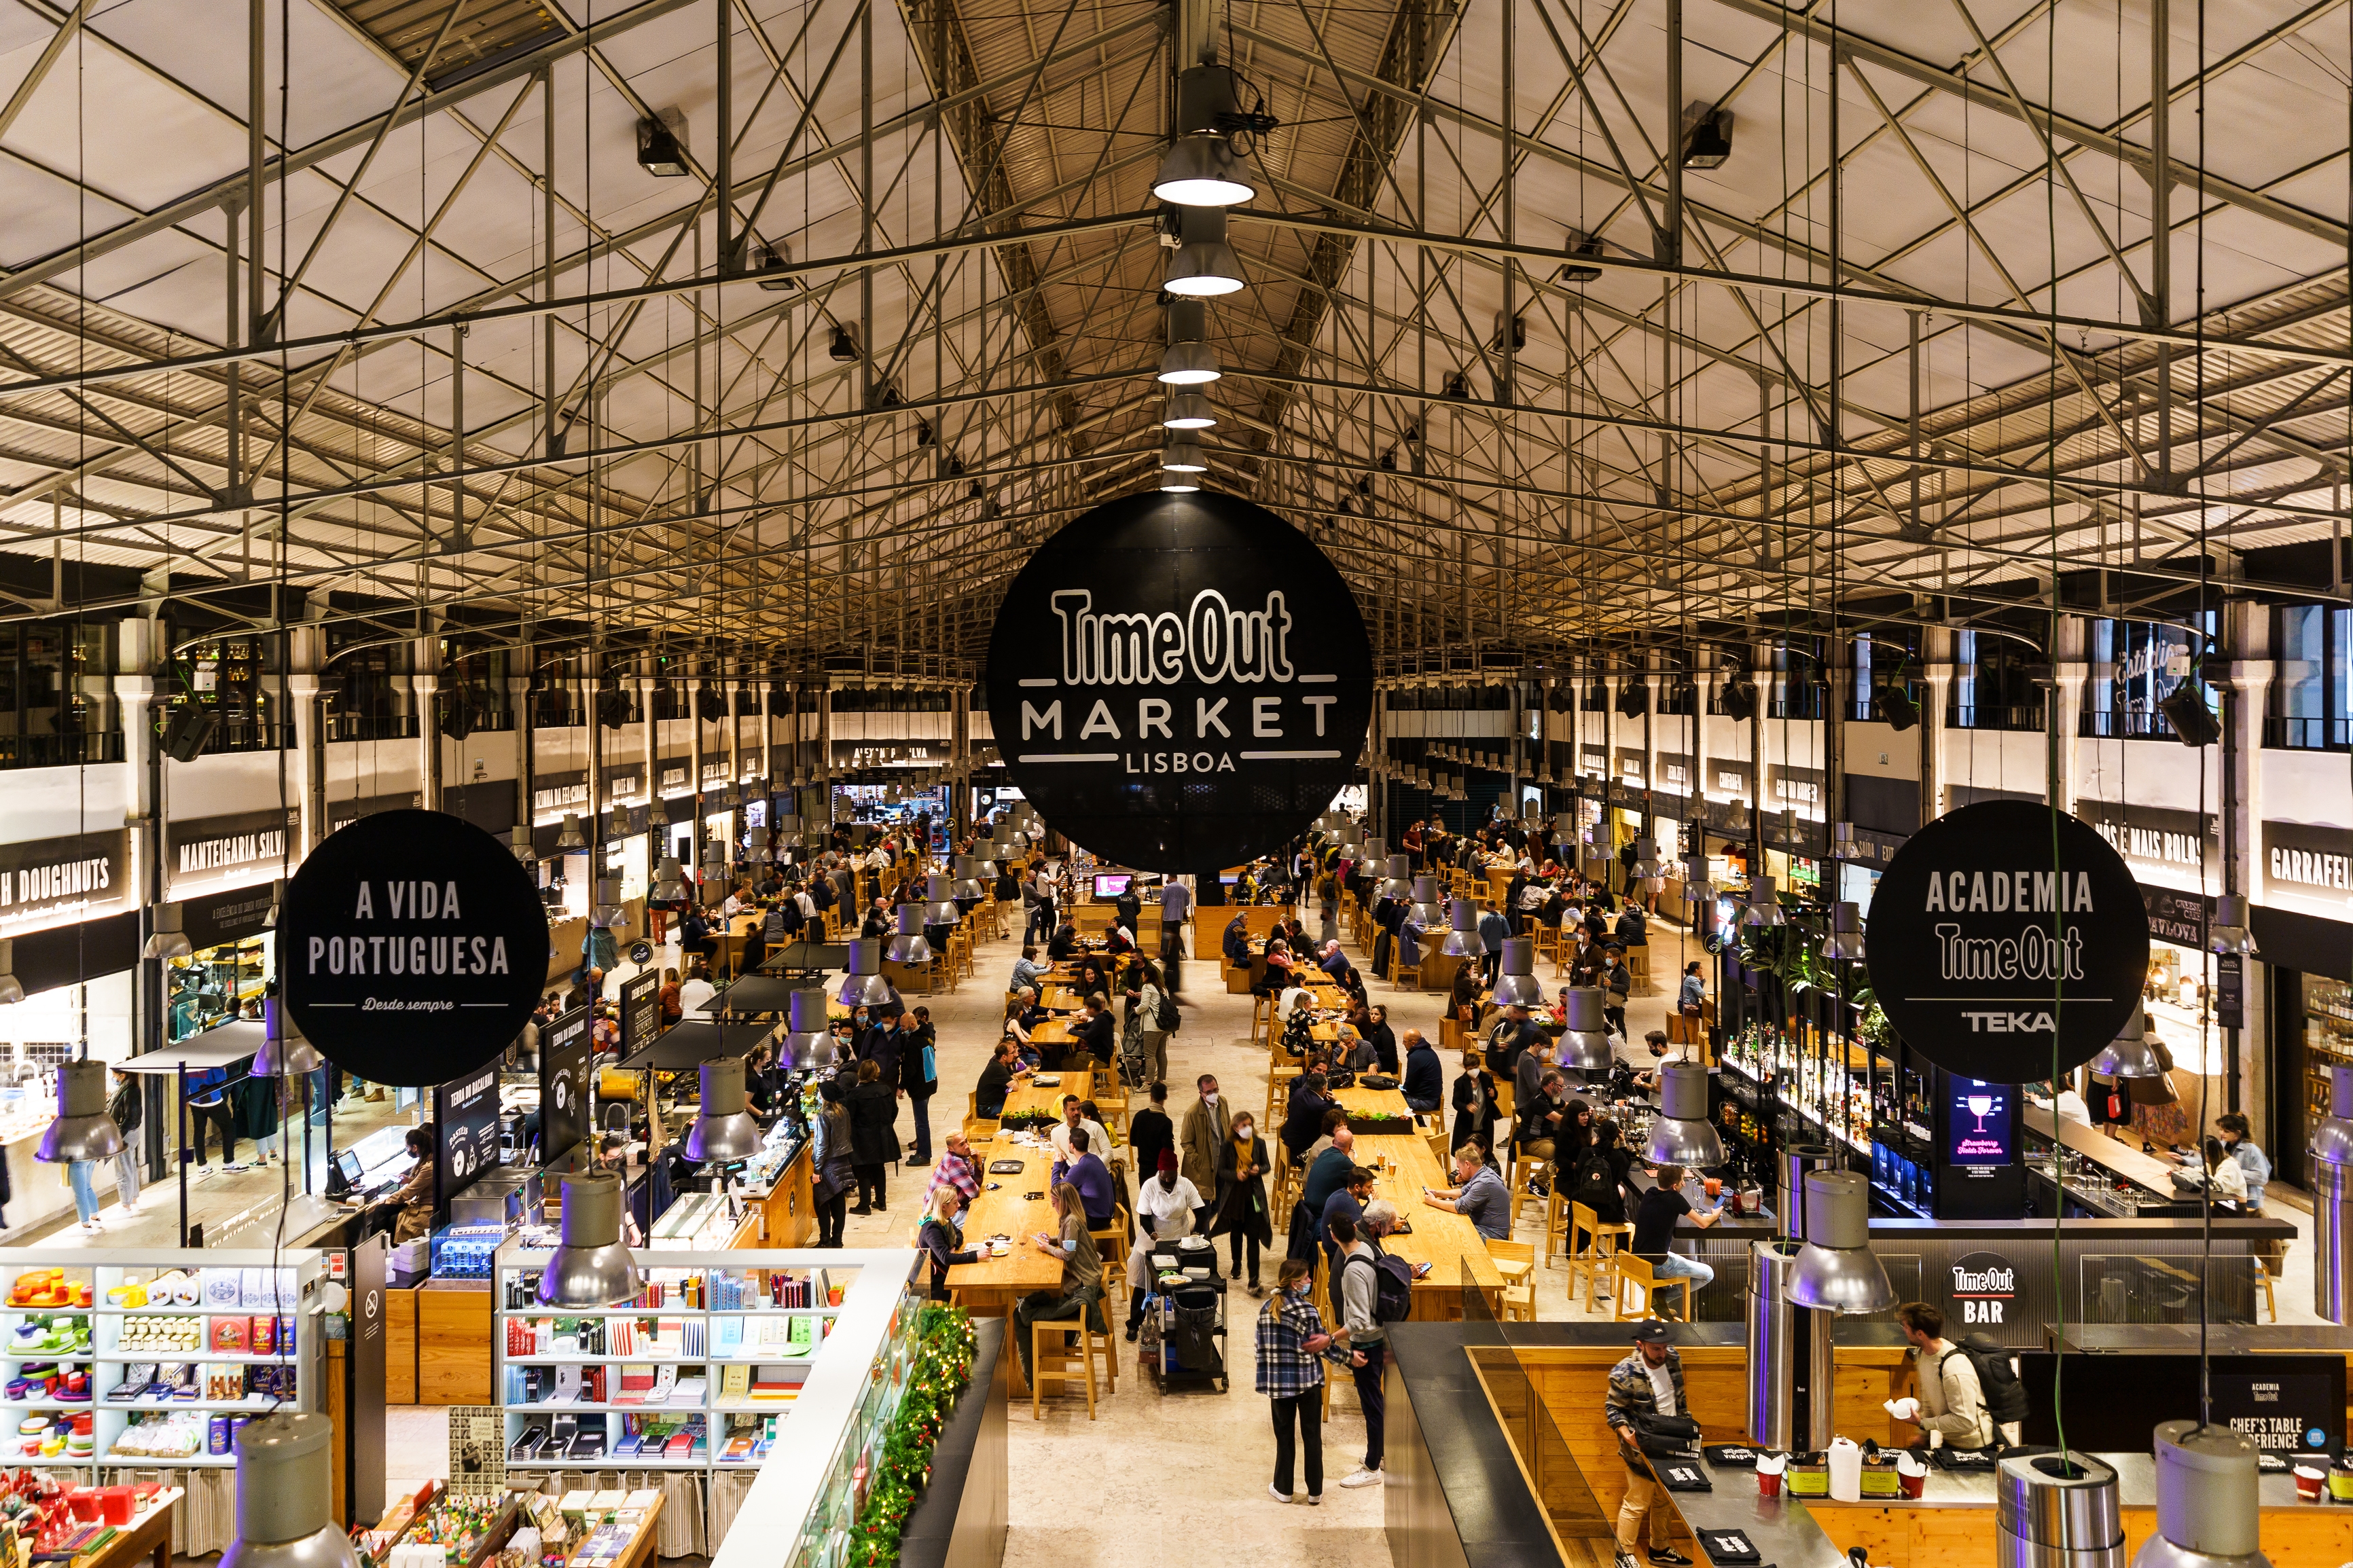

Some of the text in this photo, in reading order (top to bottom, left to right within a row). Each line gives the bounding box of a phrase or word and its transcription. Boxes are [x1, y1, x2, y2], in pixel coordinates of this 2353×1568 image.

[1022, 695, 1337, 741] MARKET
[1126, 751, 1236, 773] LISBOA
[535, 788, 554, 809] OZINHA
[180, 833, 257, 873] MANTEIGARIA
[1858, 839, 1894, 862] SAÍDA EXIT
[2130, 827, 2161, 860] MAIS
[19, 857, 109, 903] DOUGHNUTS
[2271, 847, 2353, 891] GARRAFEI
[355, 881, 461, 919] A VIDA
[1926, 871, 2094, 912] ACADEMIA
[309, 936, 509, 974] PORTUGUESA
[362, 998, 454, 1013] Desde sempre
[1962, 1012, 2056, 1032] TEKA
[1957, 1146, 2003, 1154] Fields Forever
[1961, 1138, 1999, 1148] Strawberry
[1953, 1266, 2014, 1291] Time Out
[1964, 1300, 2003, 1324] BAR
[2269, 1418, 2302, 1433] TABLE
[2247, 1434, 2299, 1448] ERIENCE
